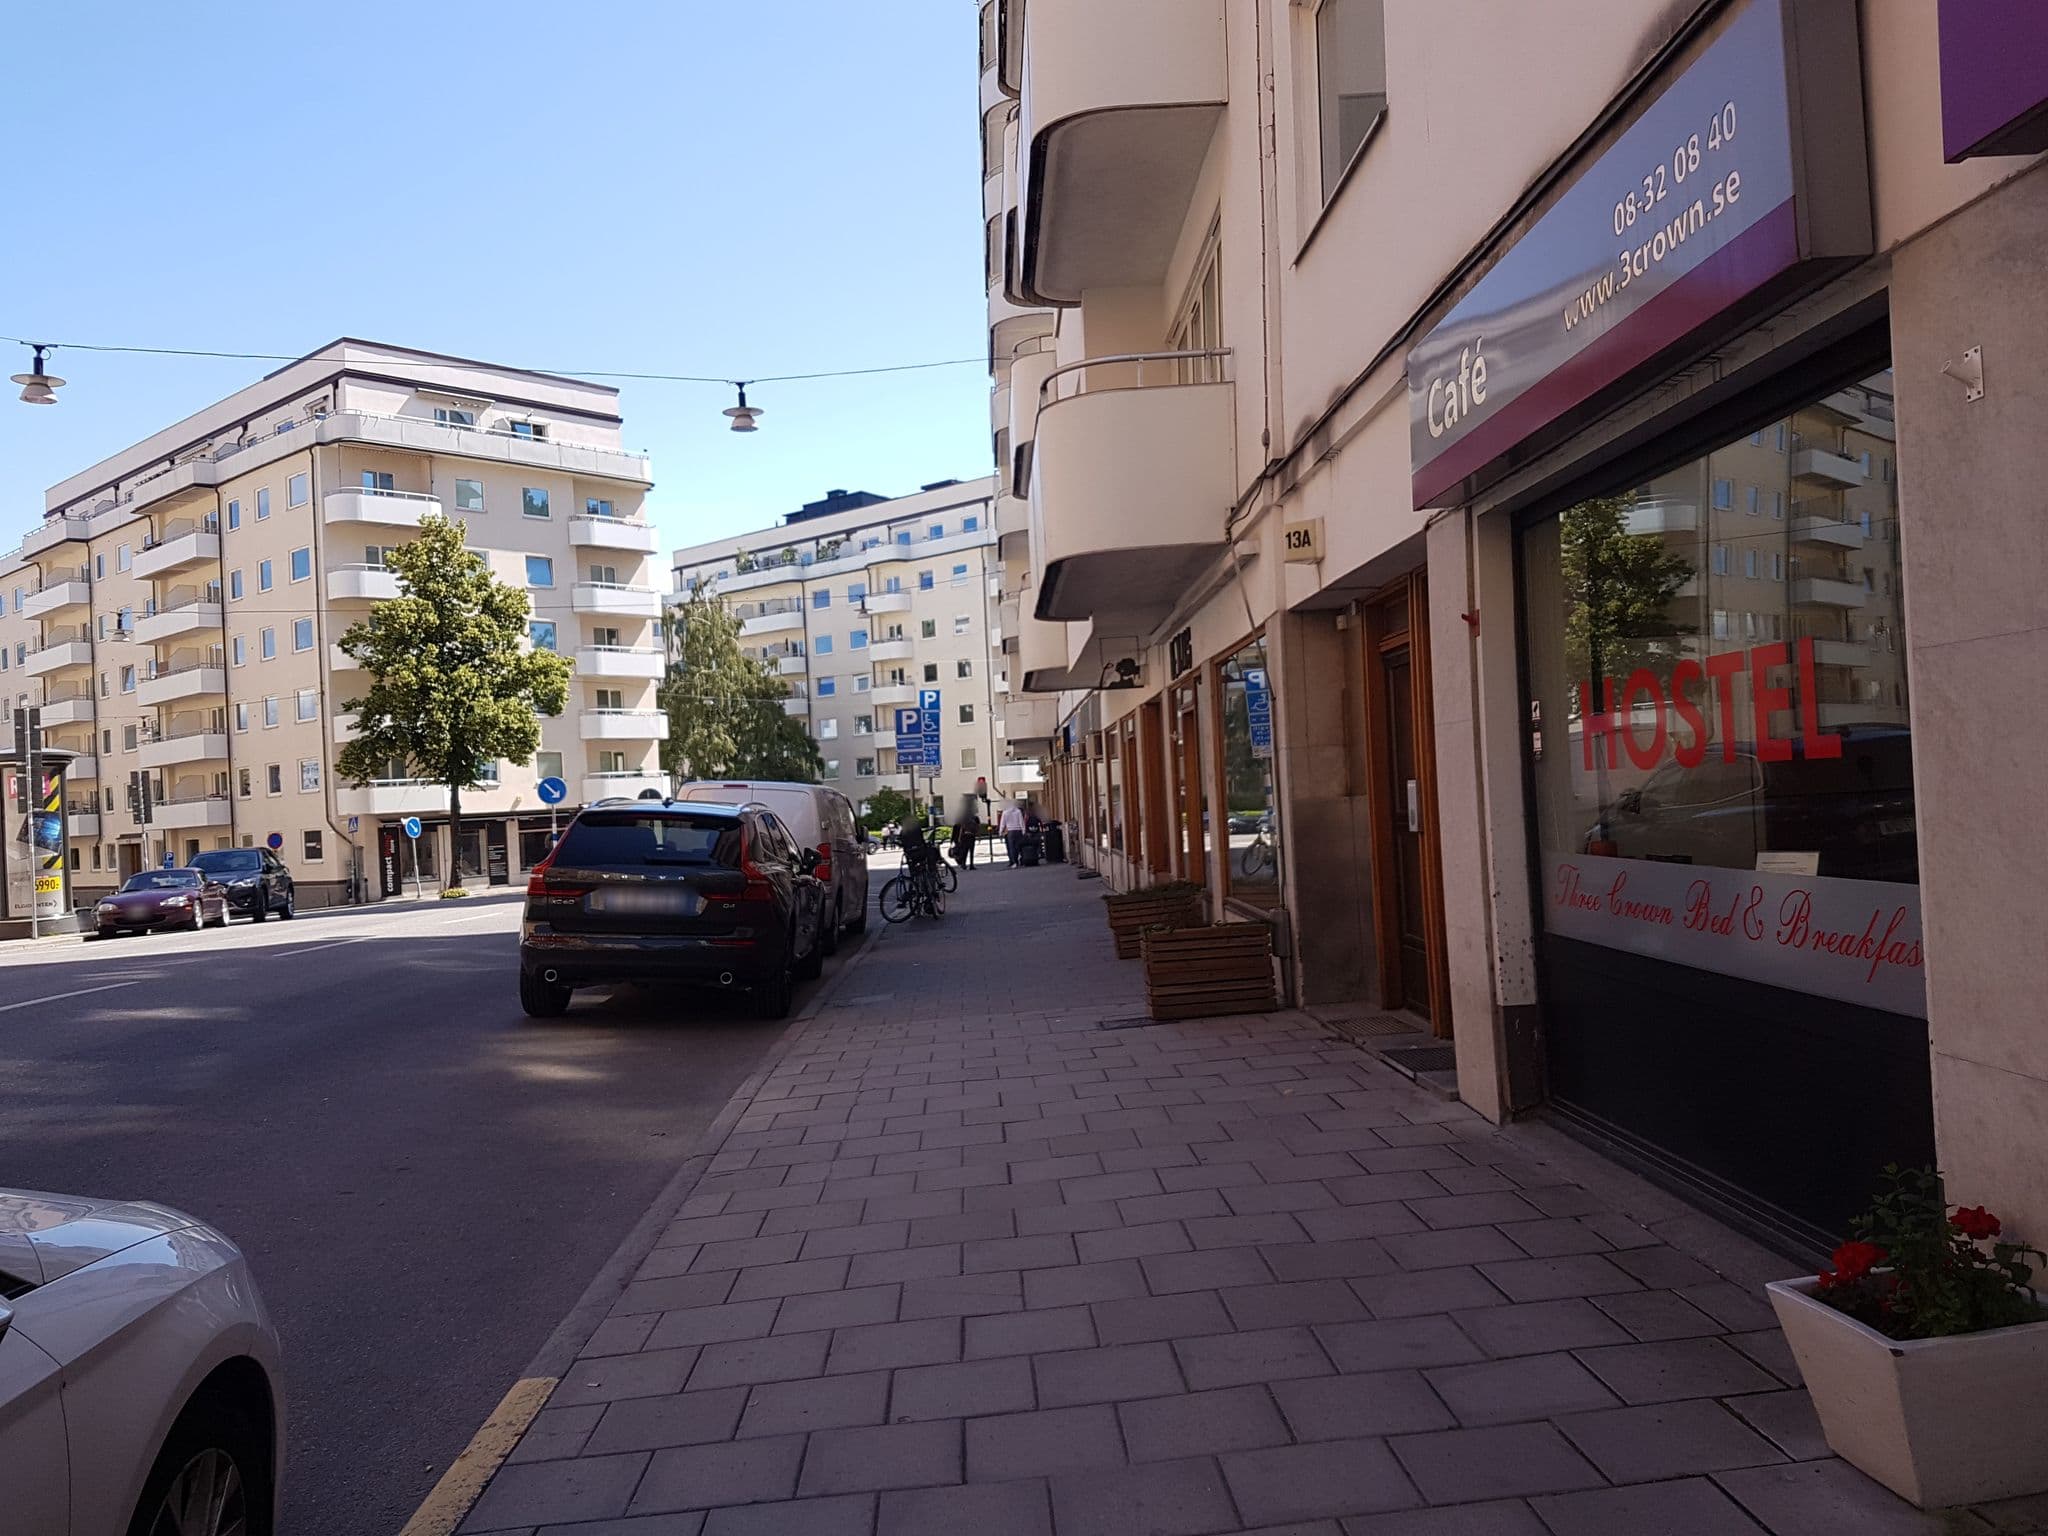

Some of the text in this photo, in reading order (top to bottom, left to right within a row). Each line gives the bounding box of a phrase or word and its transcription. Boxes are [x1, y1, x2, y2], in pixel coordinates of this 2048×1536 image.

[1613, 101, 1736, 236] 08-32 08 40
[1562, 171, 1741, 332] www.3crown.se
[1427, 336, 1486, 438] Café
[1285, 529, 1311, 549] 13A
[901, 710, 918, 733] P
[923, 691, 937, 709] P
[1580, 635, 1842, 771] HOSTEL
[167, 853, 173, 863] P
[1554, 864, 1924, 983] Three Crown Bed & Breakfas
